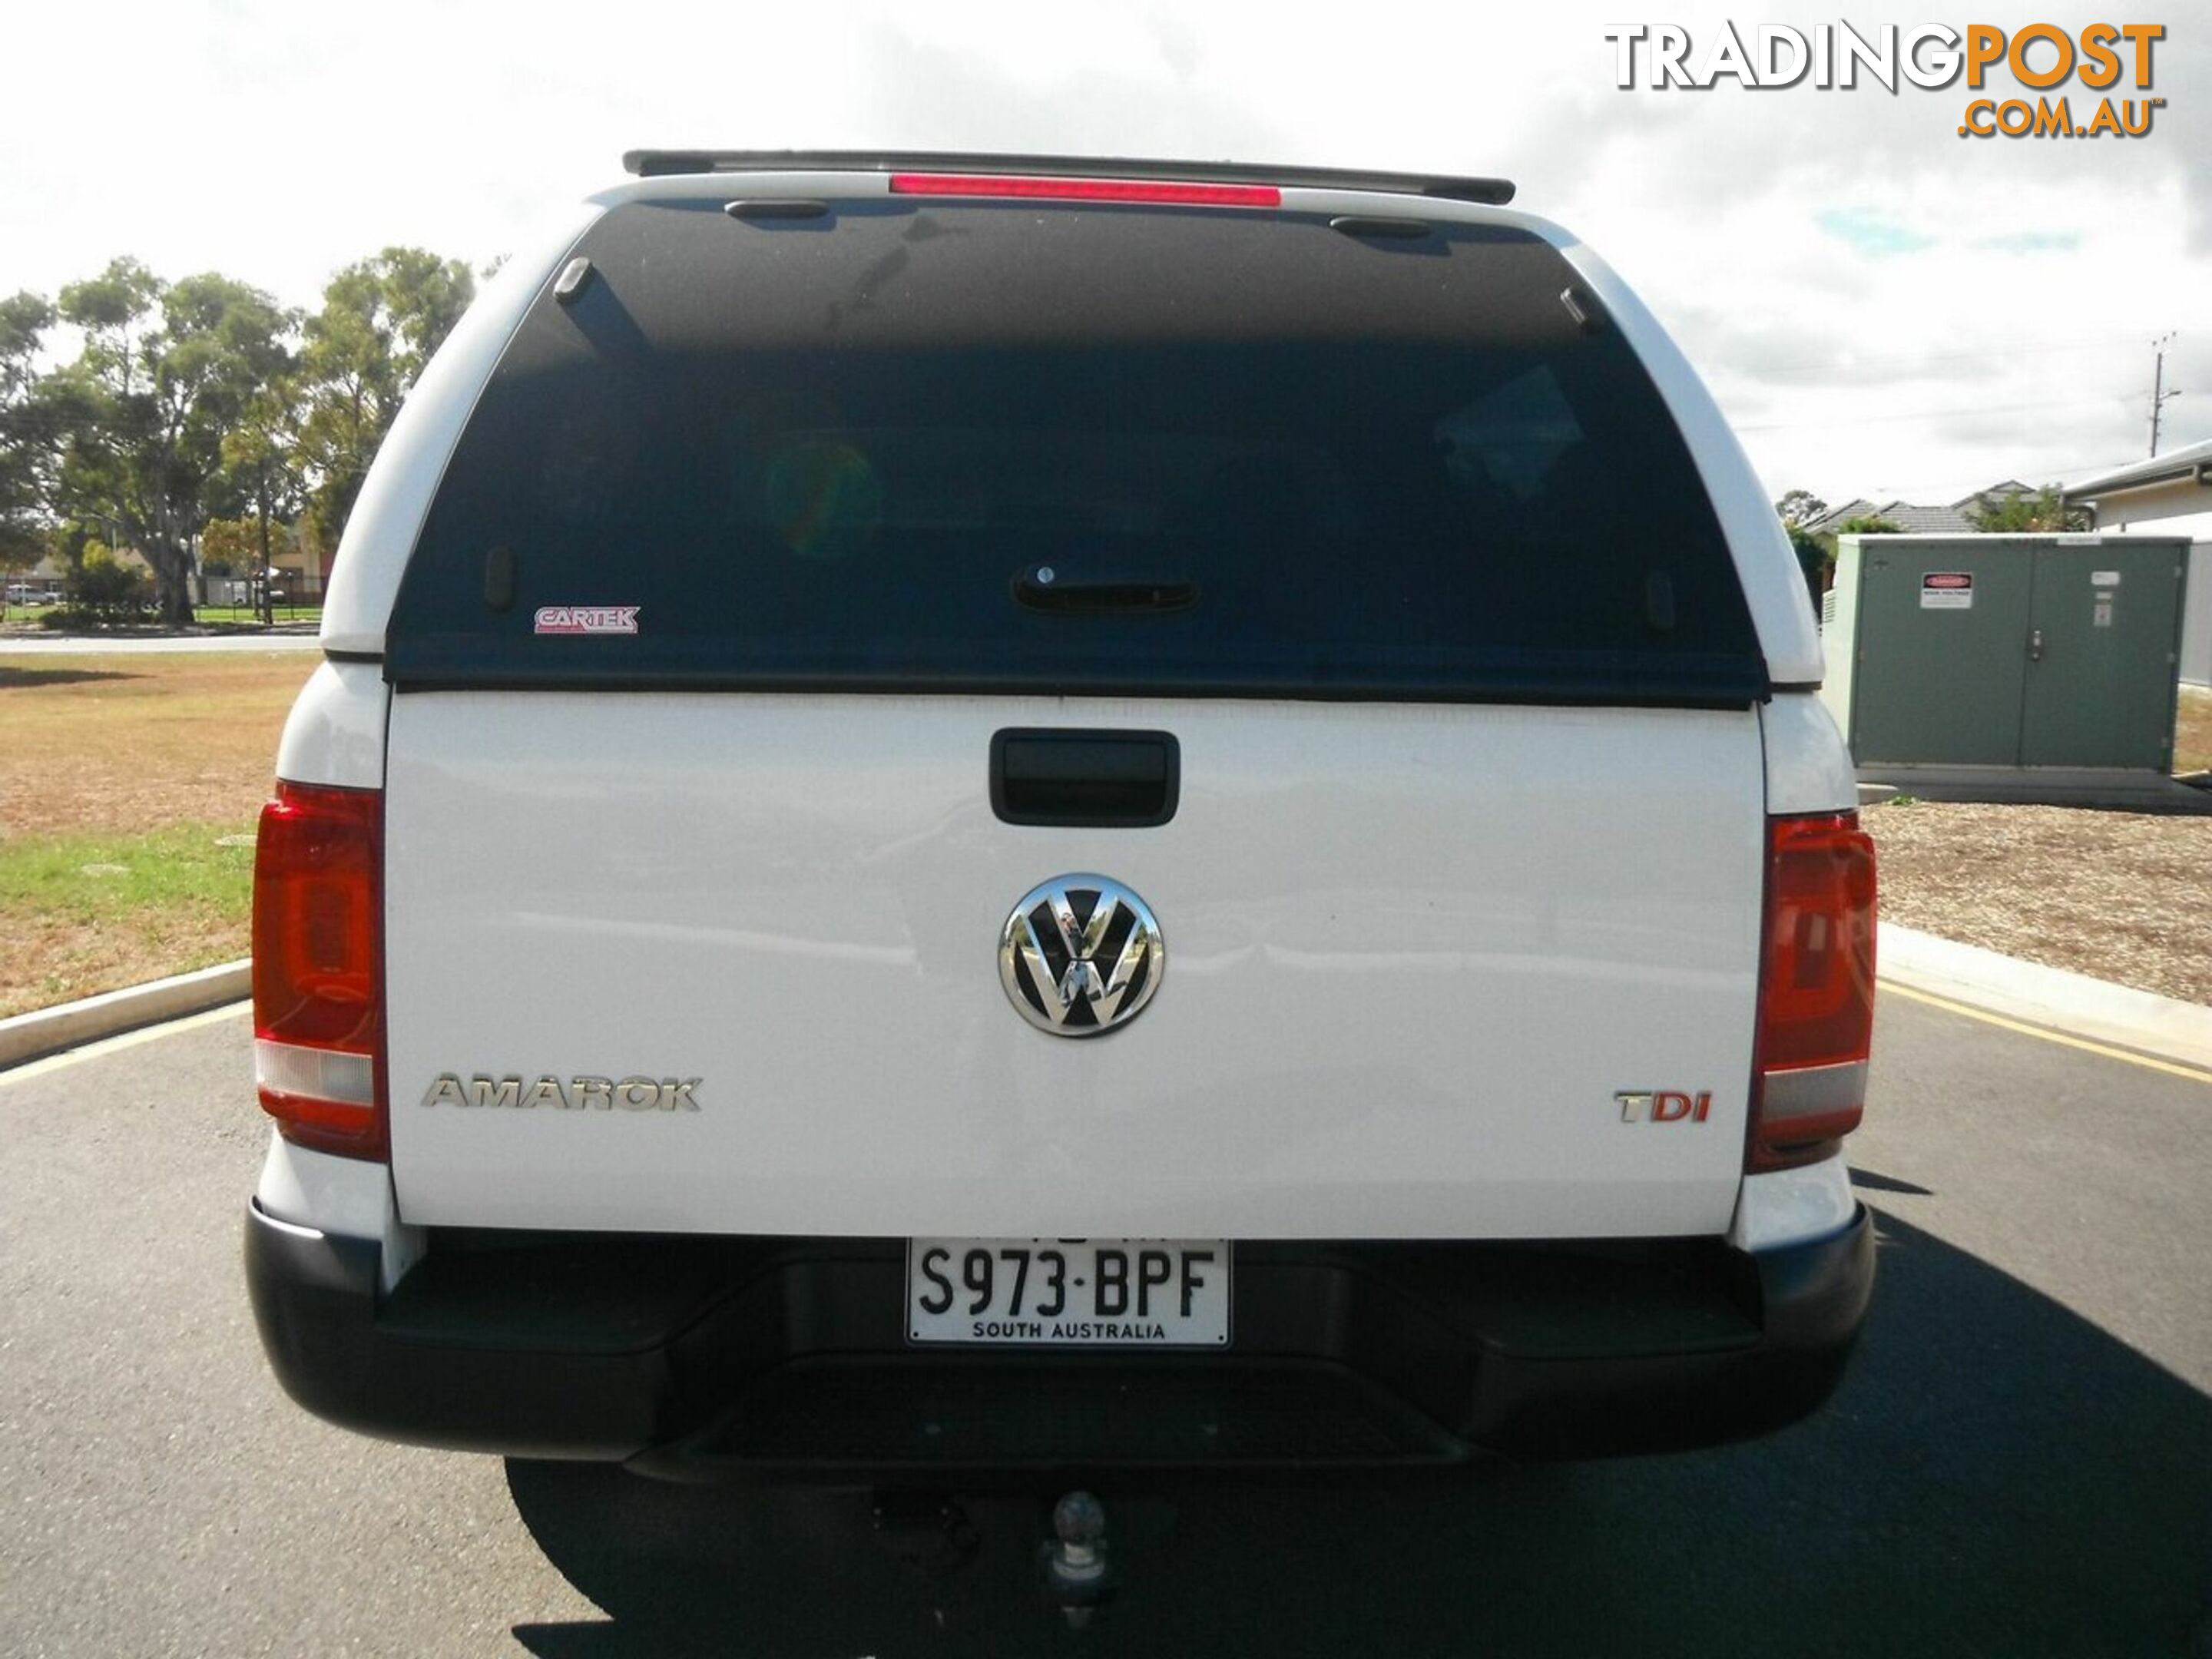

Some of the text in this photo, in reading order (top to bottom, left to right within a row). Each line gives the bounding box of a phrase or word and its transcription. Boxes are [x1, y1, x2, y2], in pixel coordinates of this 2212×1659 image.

[537, 608, 639, 632] CARTEK
[421, 1073, 702, 1111] AMAROK
[1614, 1091, 1712, 1122] TDI
[973, 1322, 1165, 1339] SOUTH AUSTRALIA
